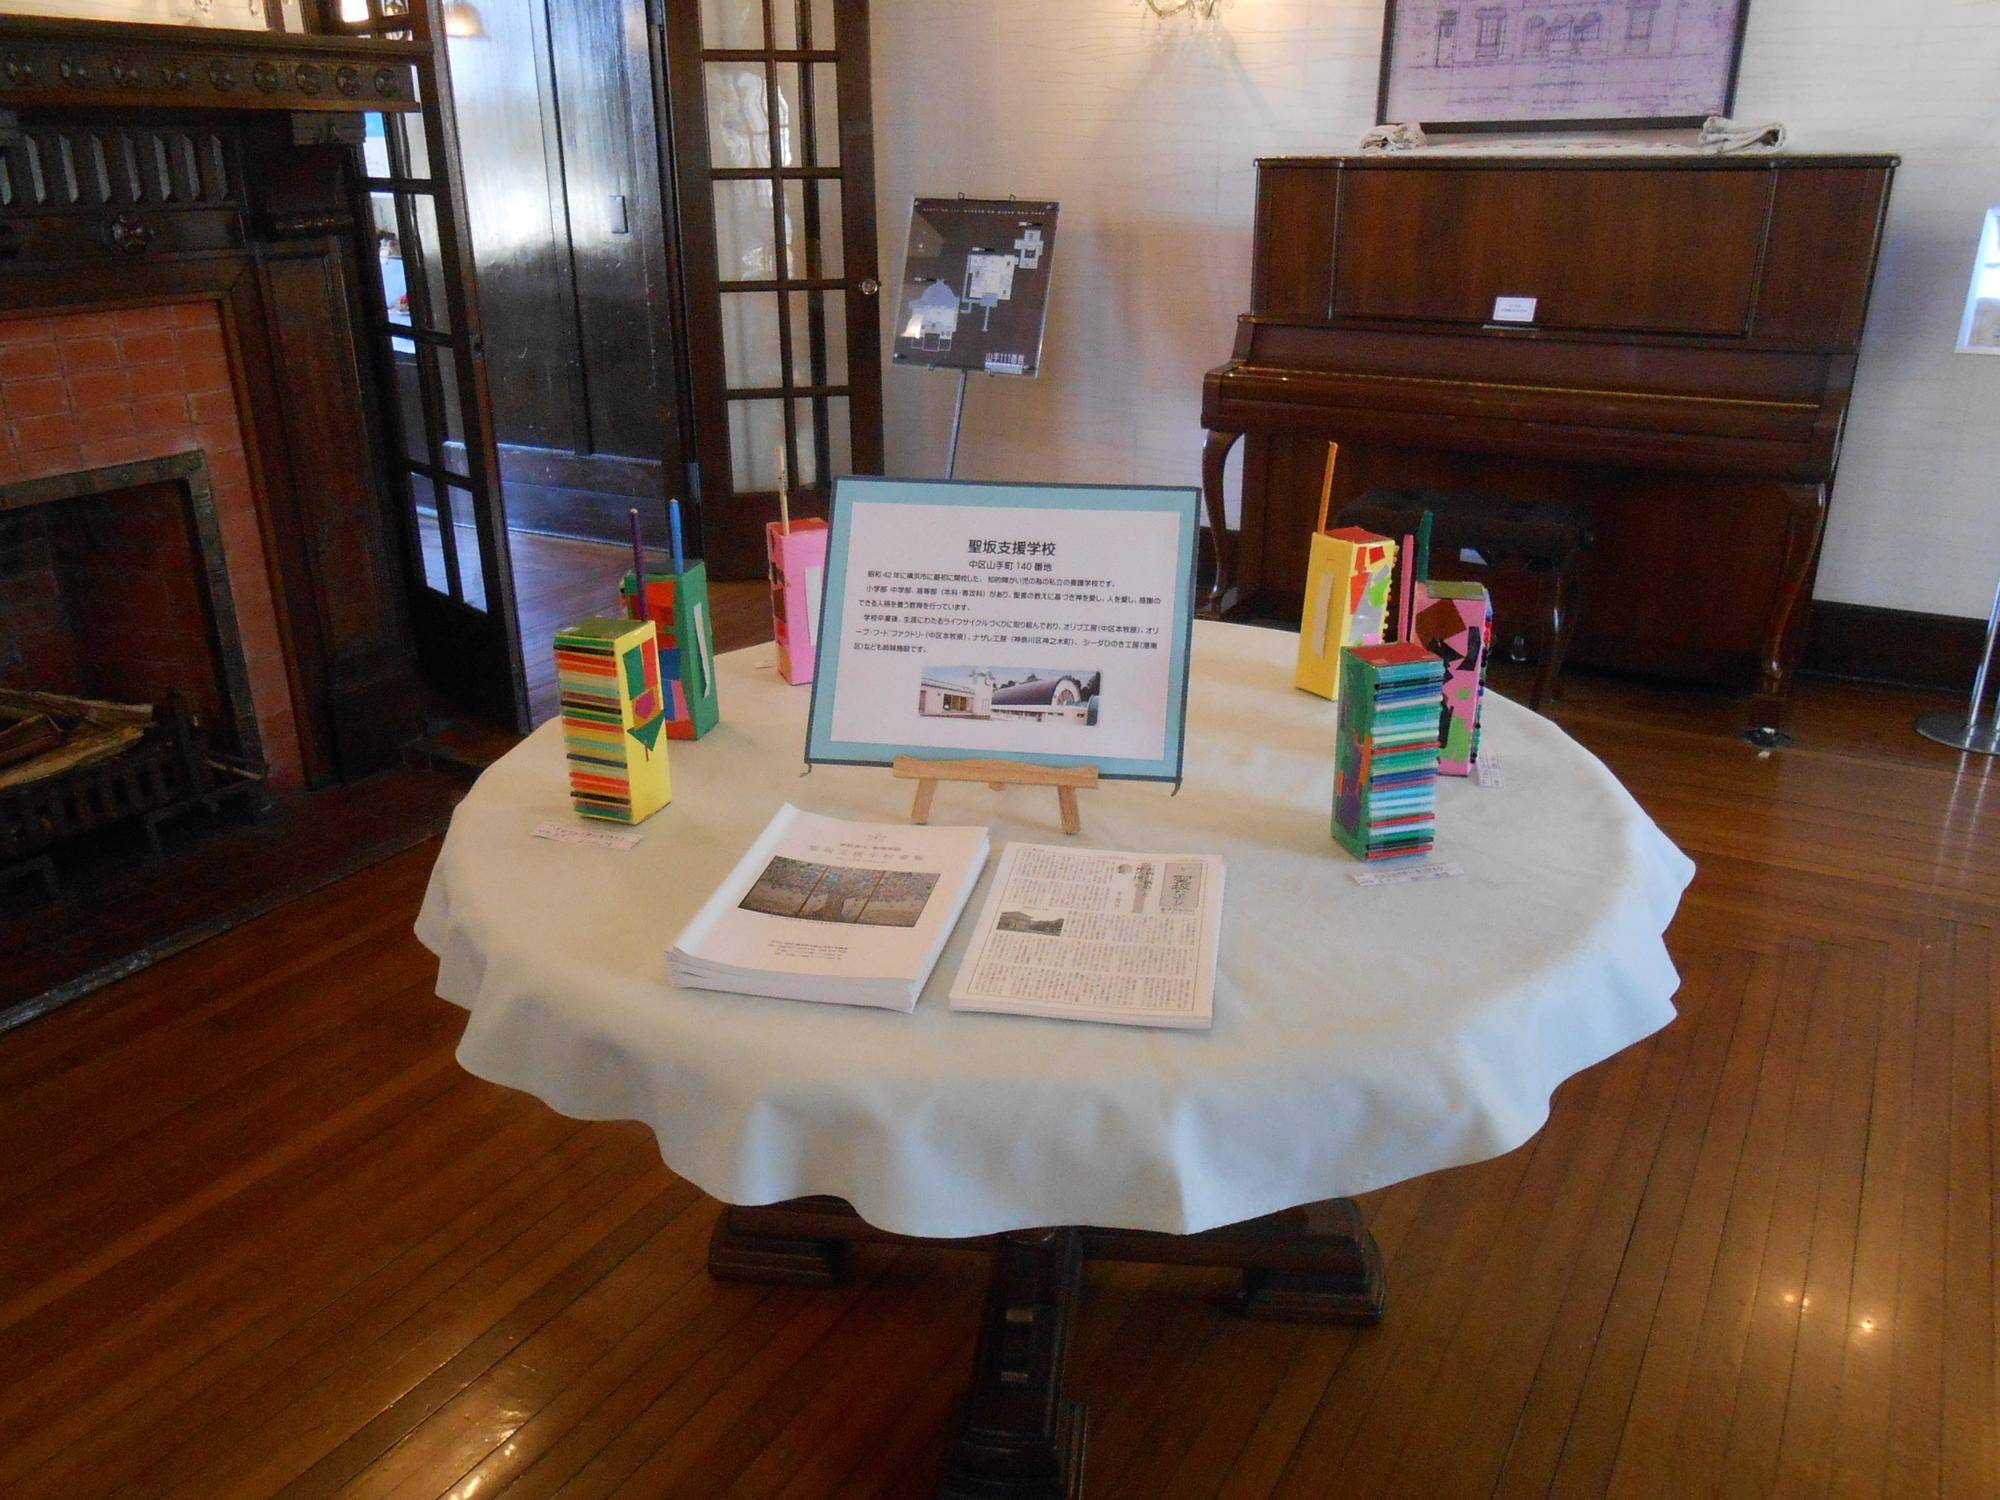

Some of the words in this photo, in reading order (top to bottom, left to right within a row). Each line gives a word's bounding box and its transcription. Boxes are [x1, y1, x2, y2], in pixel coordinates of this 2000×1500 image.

[968, 539, 1056, 556] 聖坂支援学校
[969, 560, 1013, 570] 中区山手町
[1016, 562, 1032, 570] 140
[1034, 562, 1053, 572] 番地
